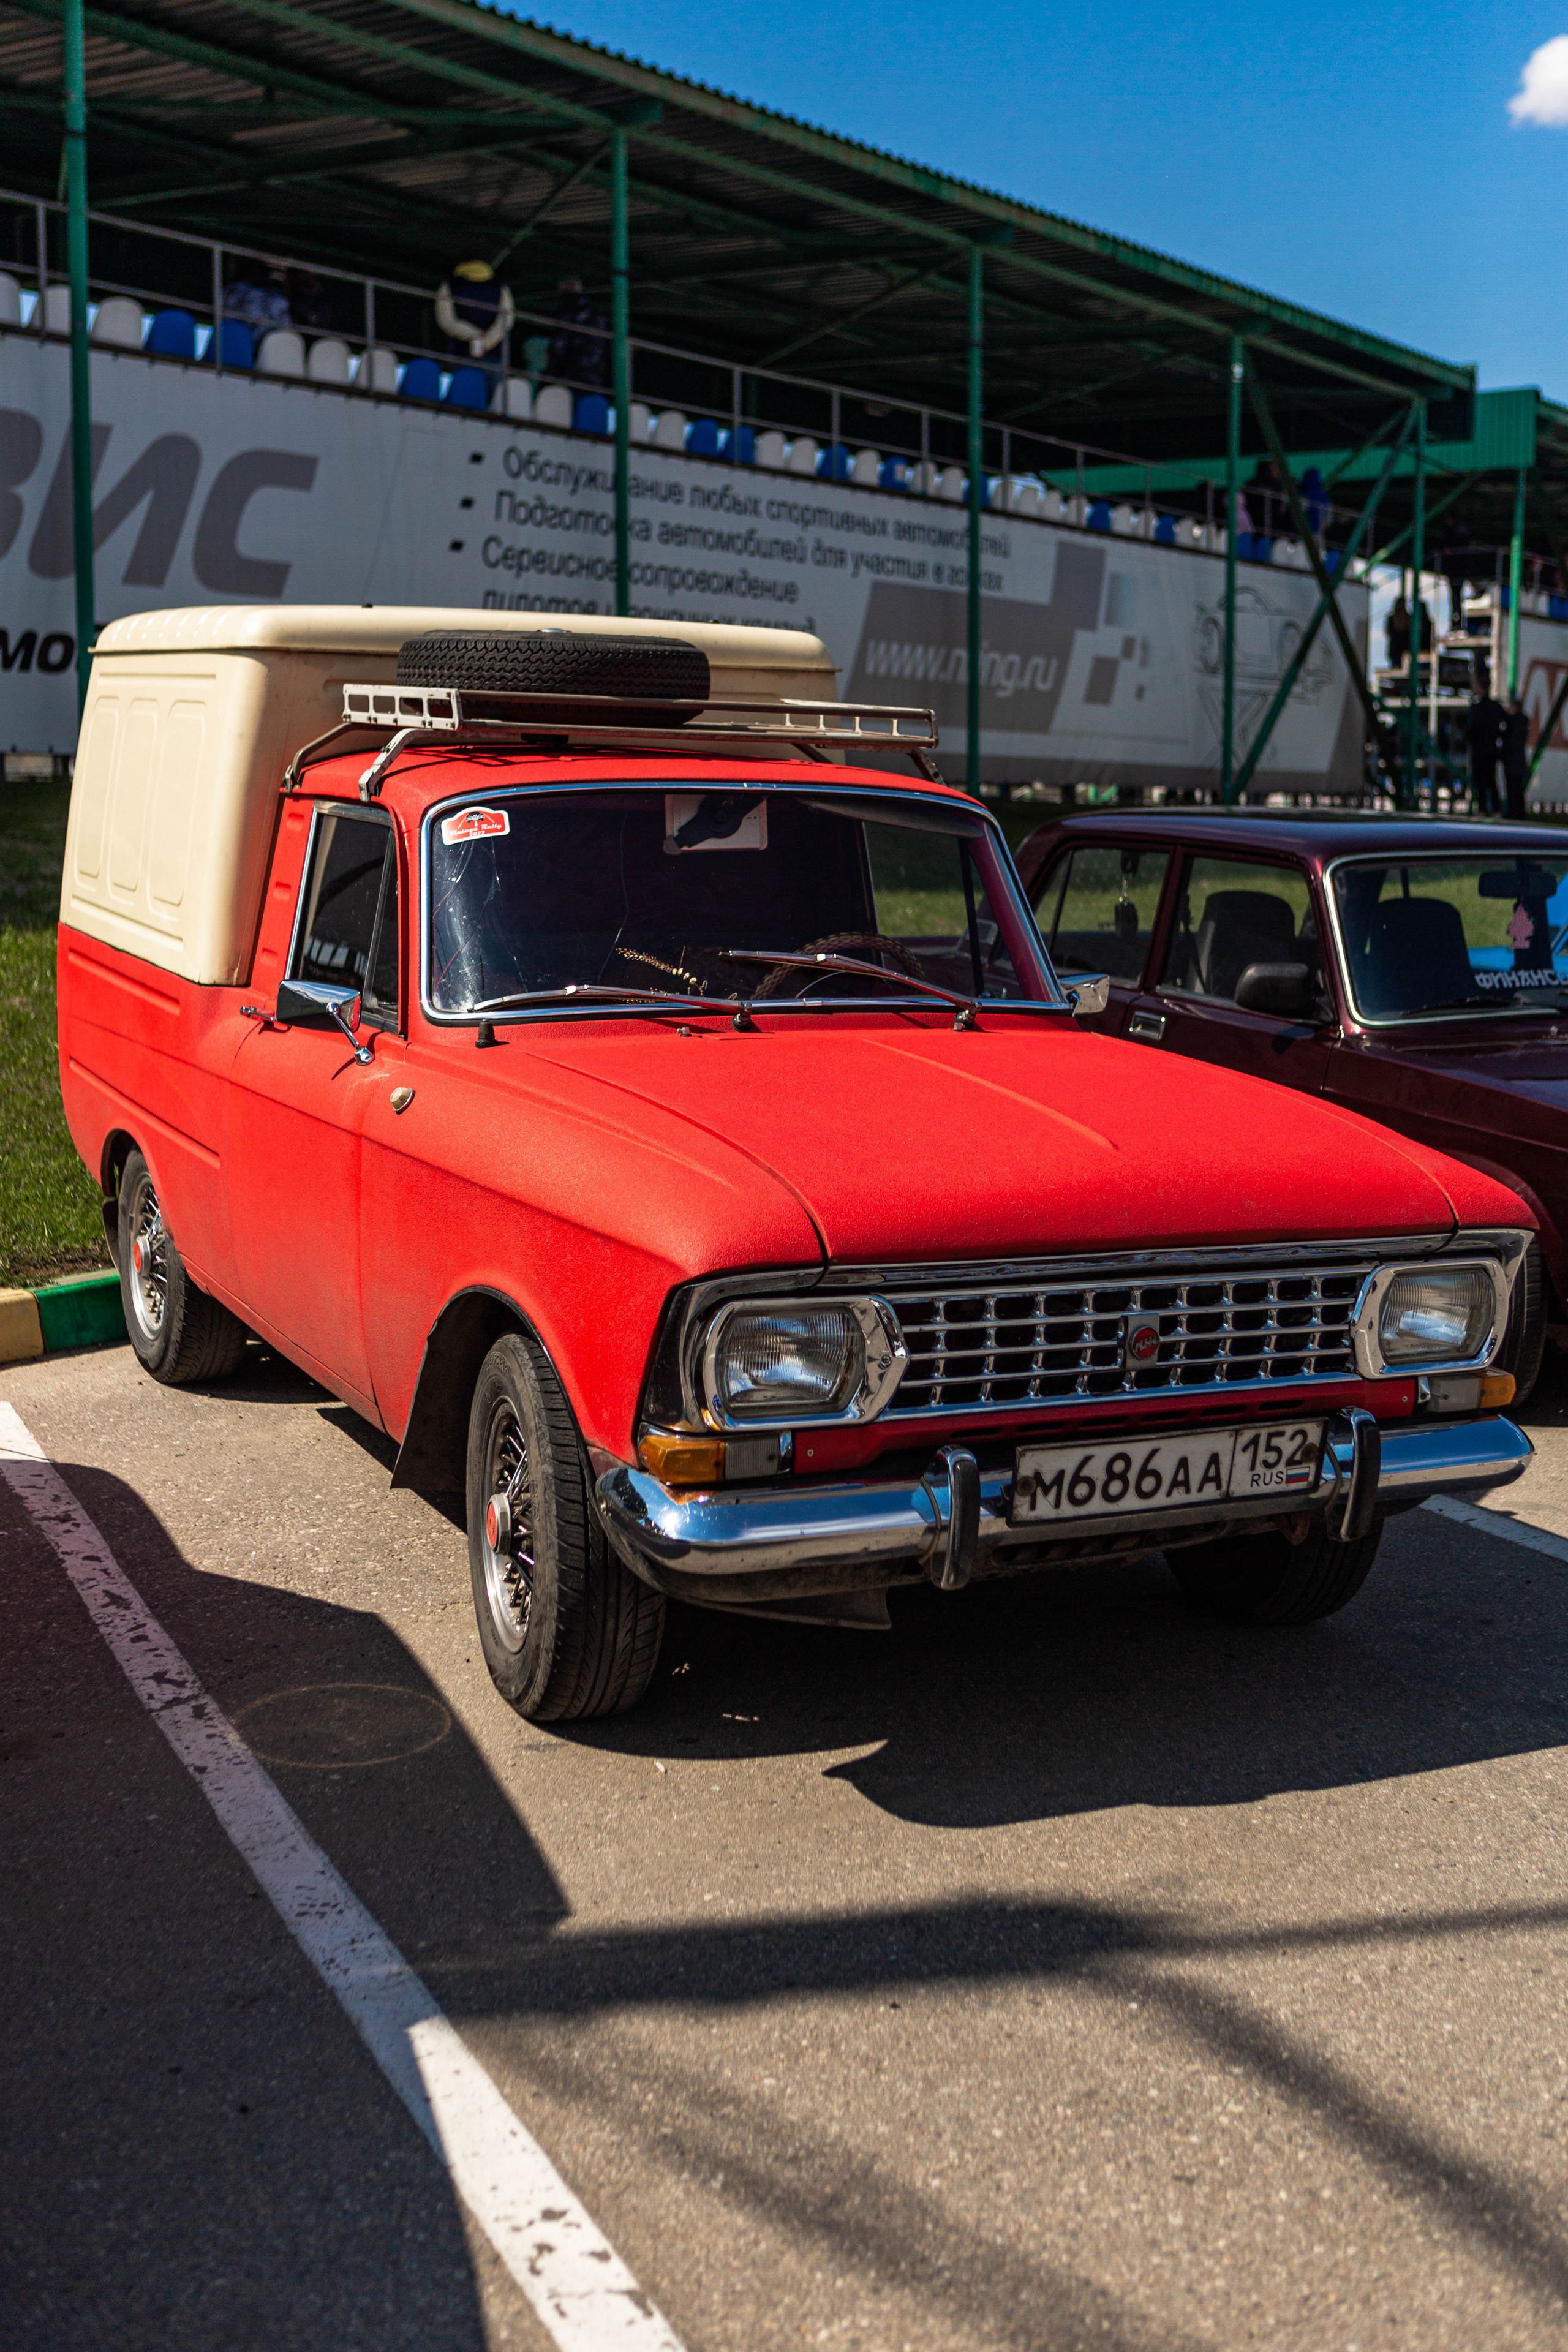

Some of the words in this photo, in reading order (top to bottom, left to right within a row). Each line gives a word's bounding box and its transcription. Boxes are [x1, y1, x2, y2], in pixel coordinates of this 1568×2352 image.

[502, 445, 684, 506] Обслужиание
[688, 483, 763, 518] любых
[766, 497, 889, 539] спортивных
[495, 489, 652, 543] Подготока
[657, 521, 807, 565] автомобилей
[811, 537, 848, 569] для
[849, 551, 928, 579] участия
[932, 562, 945, 585] в
[629, 561, 799, 605] сопровождение
[1240, 1428, 1309, 1472] 152
[1250, 1470, 1284, 1488] RUS
